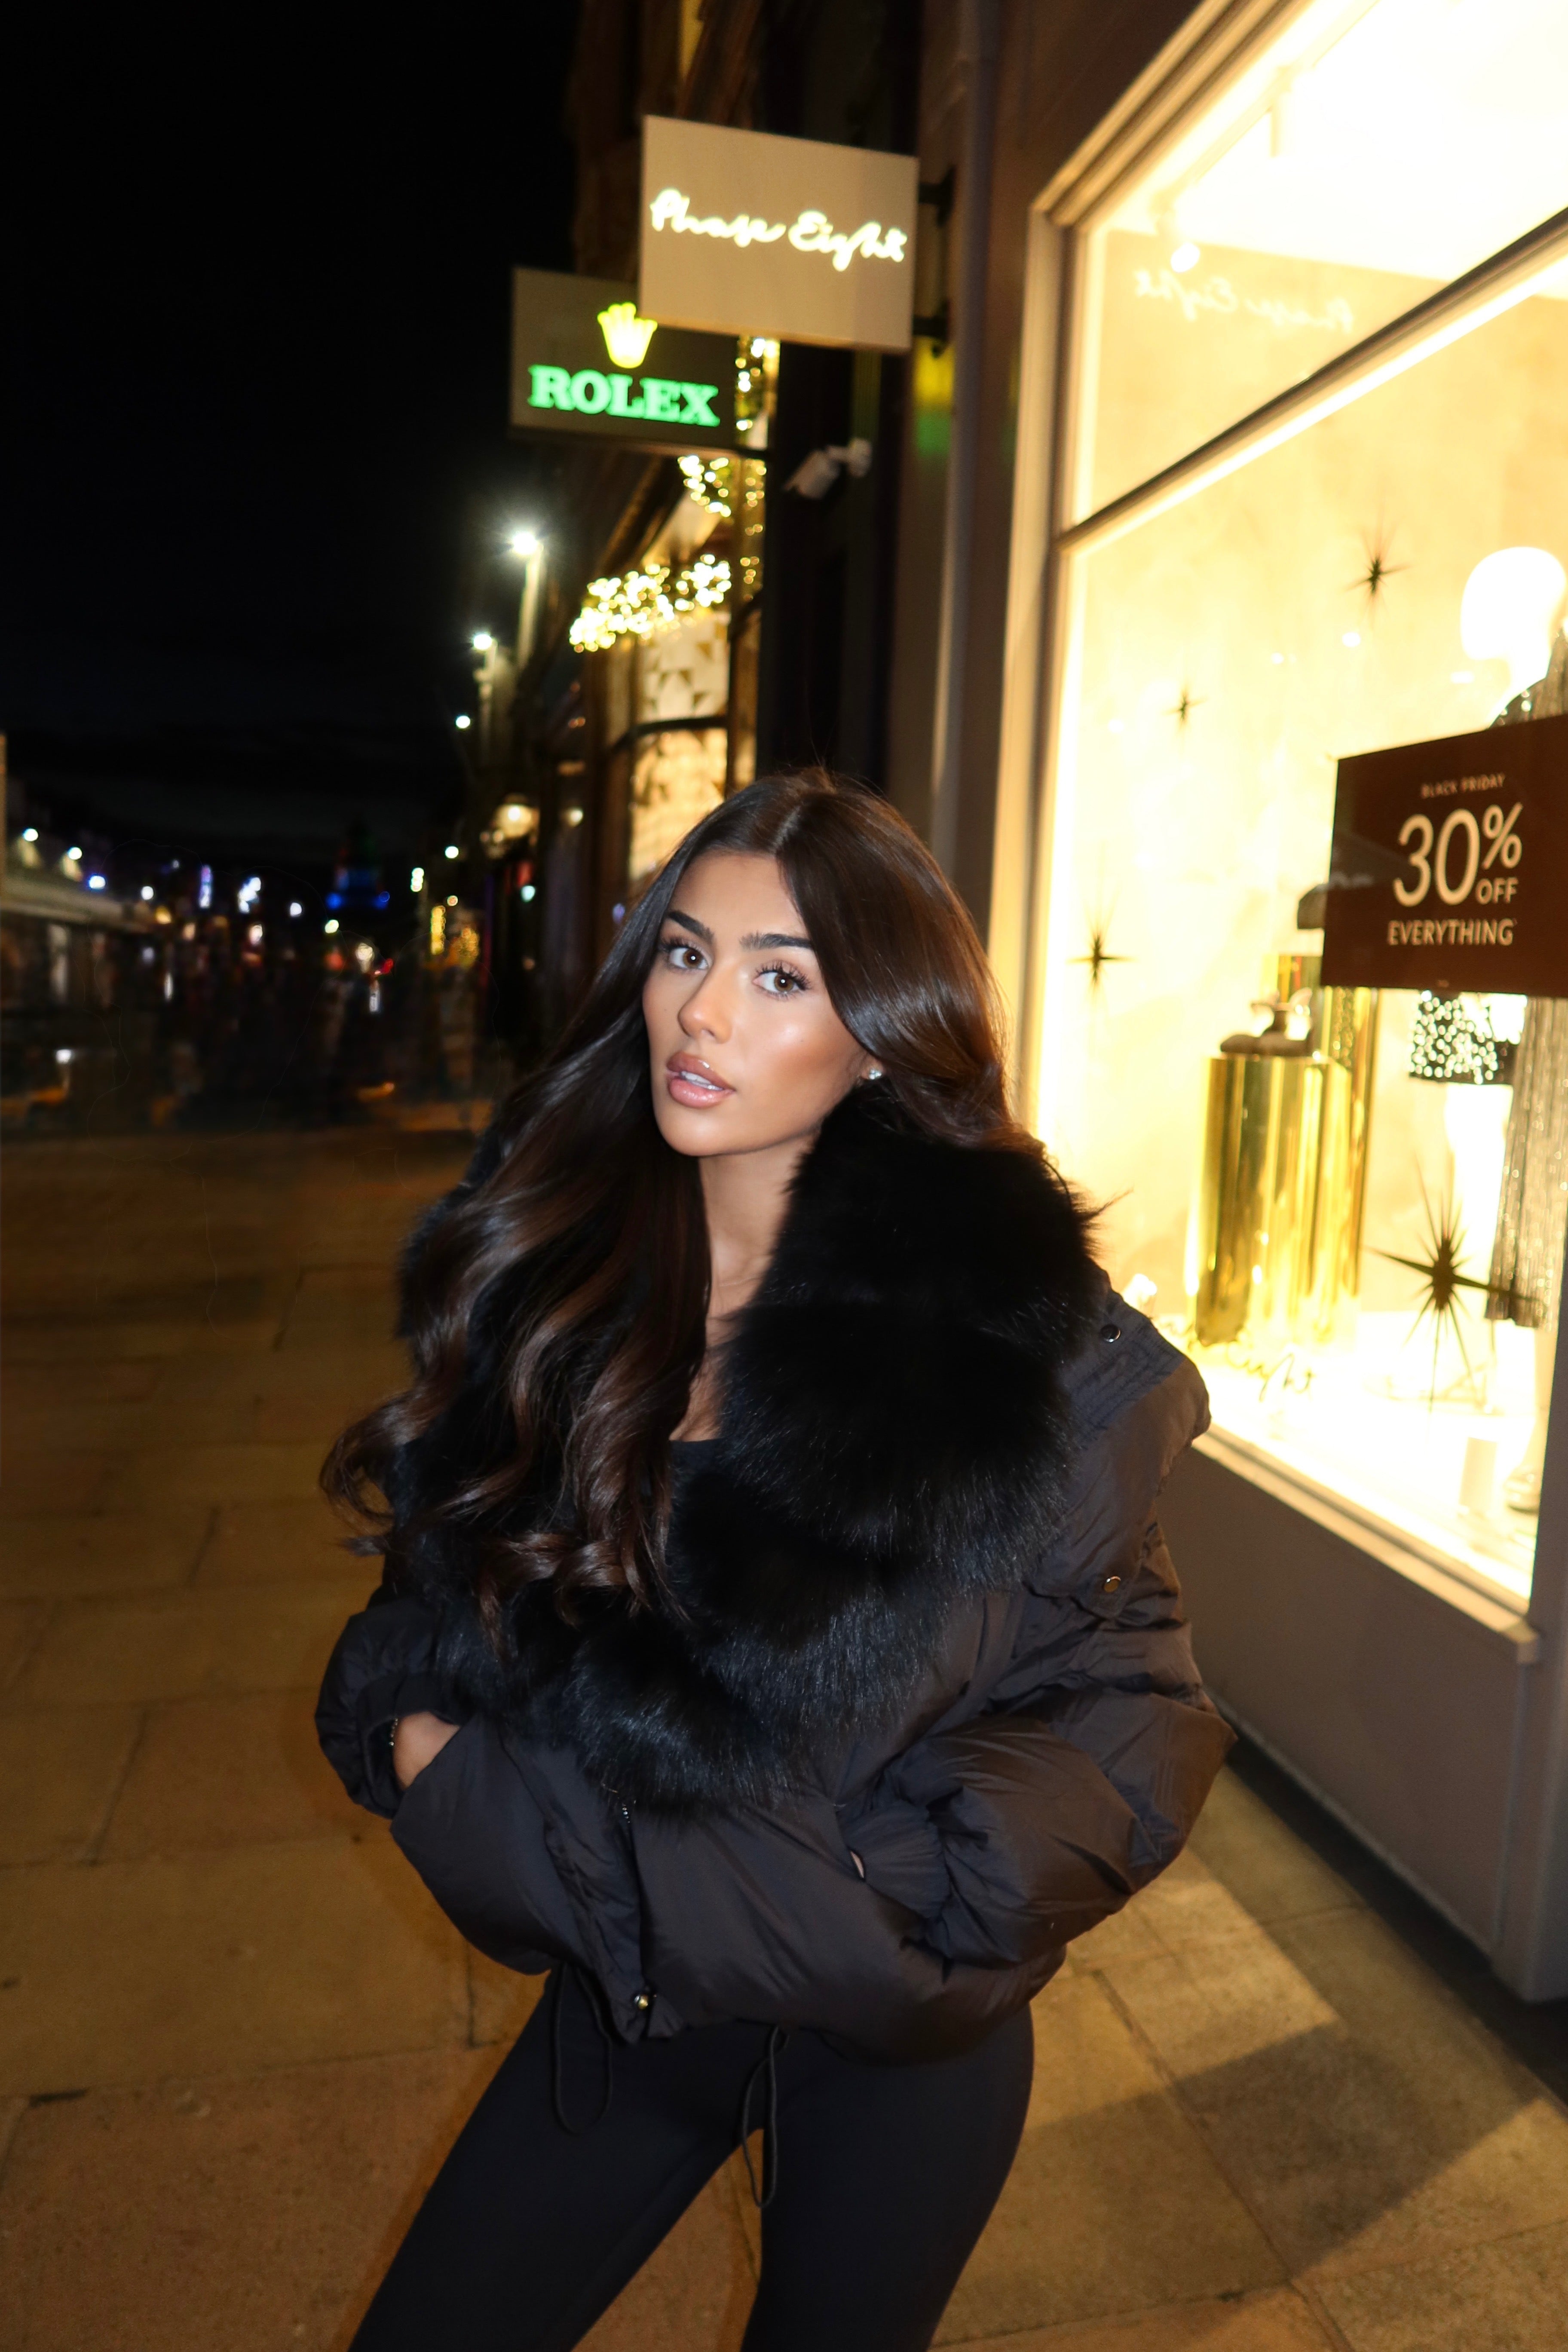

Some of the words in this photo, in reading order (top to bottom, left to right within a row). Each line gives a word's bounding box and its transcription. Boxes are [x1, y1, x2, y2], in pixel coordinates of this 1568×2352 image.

[649, 188, 786, 248] Phase
[788, 210, 908, 272] Eight
[527, 364, 720, 427] ROLEX
[1421, 779, 1458, 799] BLACK
[1461, 772, 1505, 793] FRIDAY
[1393, 802, 1523, 907] 30%
[1475, 877, 1519, 904] OFF
